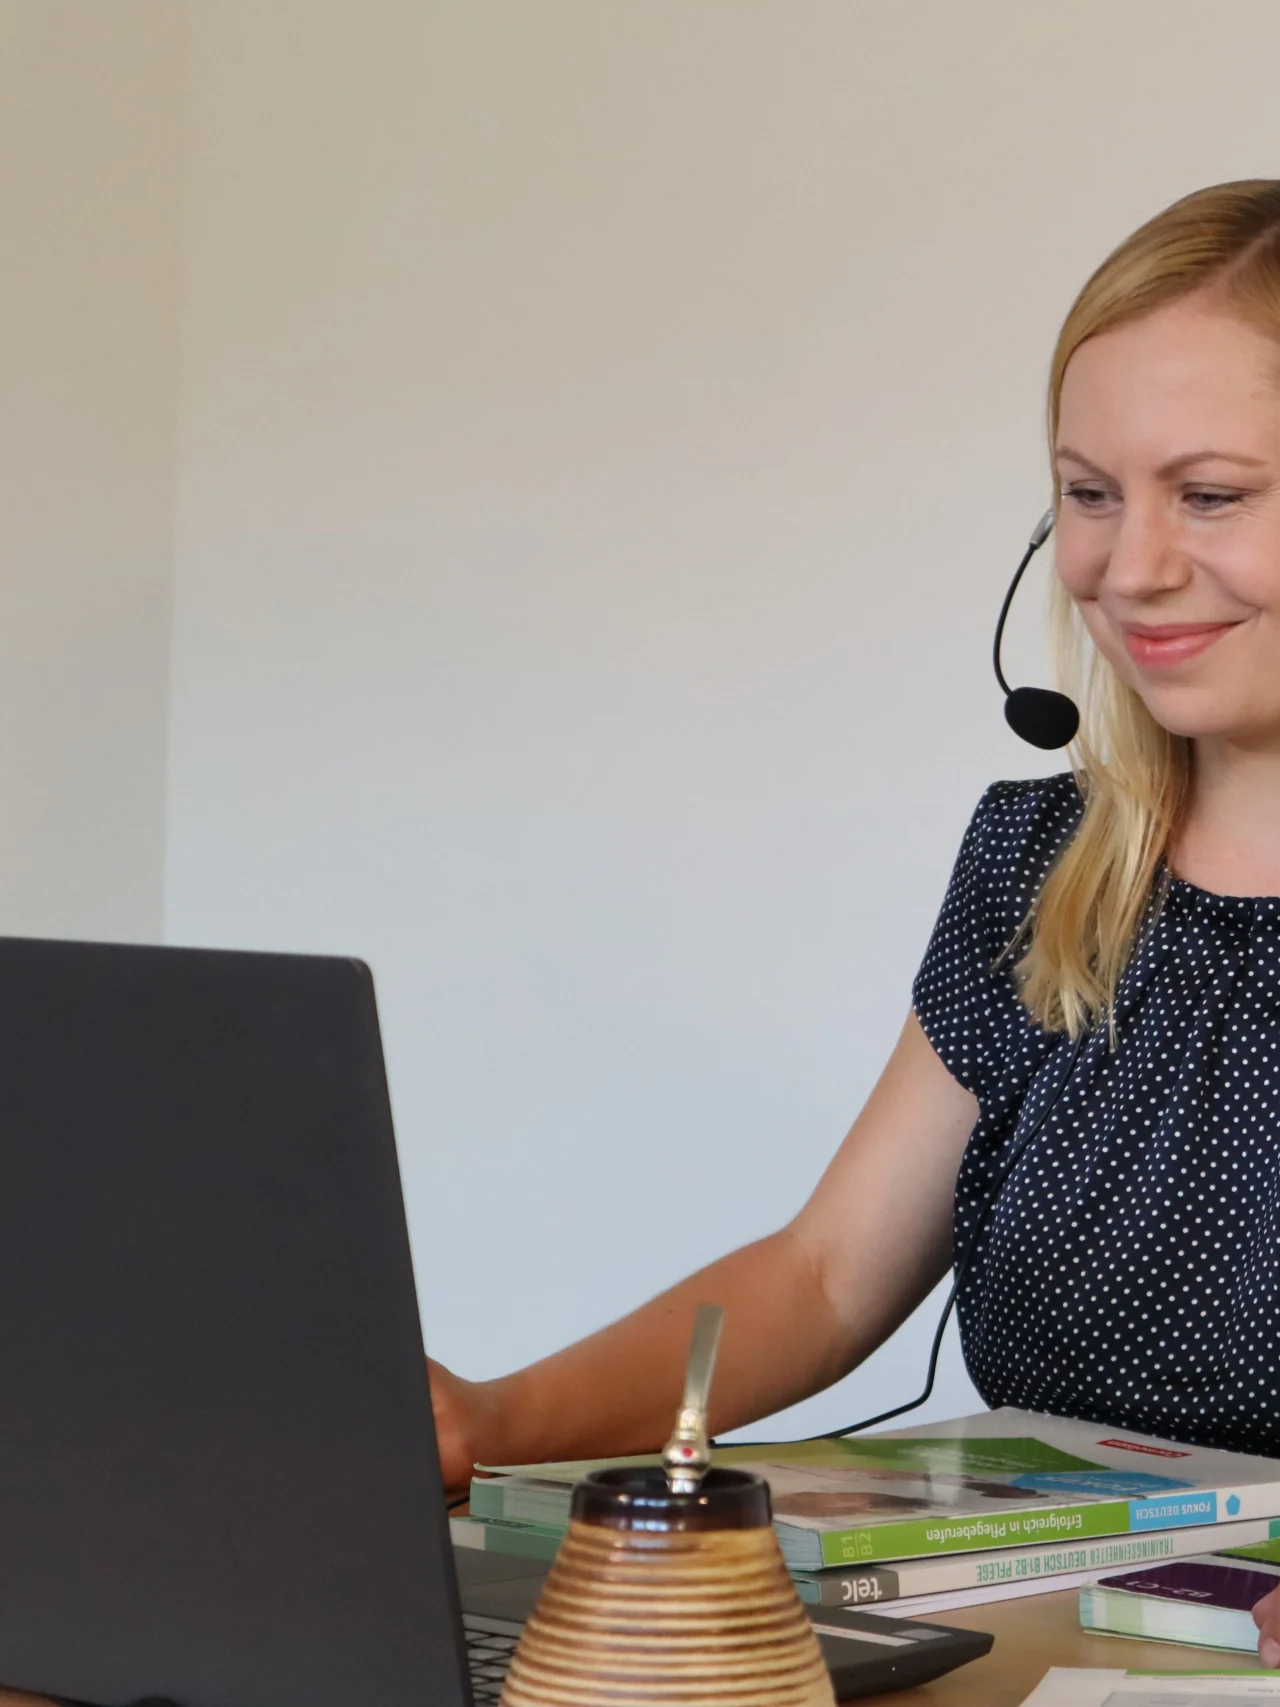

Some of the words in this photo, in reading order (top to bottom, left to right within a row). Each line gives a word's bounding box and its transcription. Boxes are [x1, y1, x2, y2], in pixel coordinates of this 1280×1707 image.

[1135, 1505, 1180, 1521] DEUTSCH
[1181, 1501, 1212, 1516] FOKUS
[926, 1520, 1007, 1544] Pflegeberufen
[1009, 1521, 1021, 1532] in
[1023, 1514, 1082, 1533] Erfolgreich
[841, 1535, 855, 1559] B1
[858, 1531, 873, 1557] B2
[1090, 1537, 1175, 1565] TRAININGSEINHEITEN
[976, 1562, 1012, 1582] PFLEGE
[1043, 1550, 1087, 1572] DEUTSCH
[841, 1576, 882, 1602] telc
